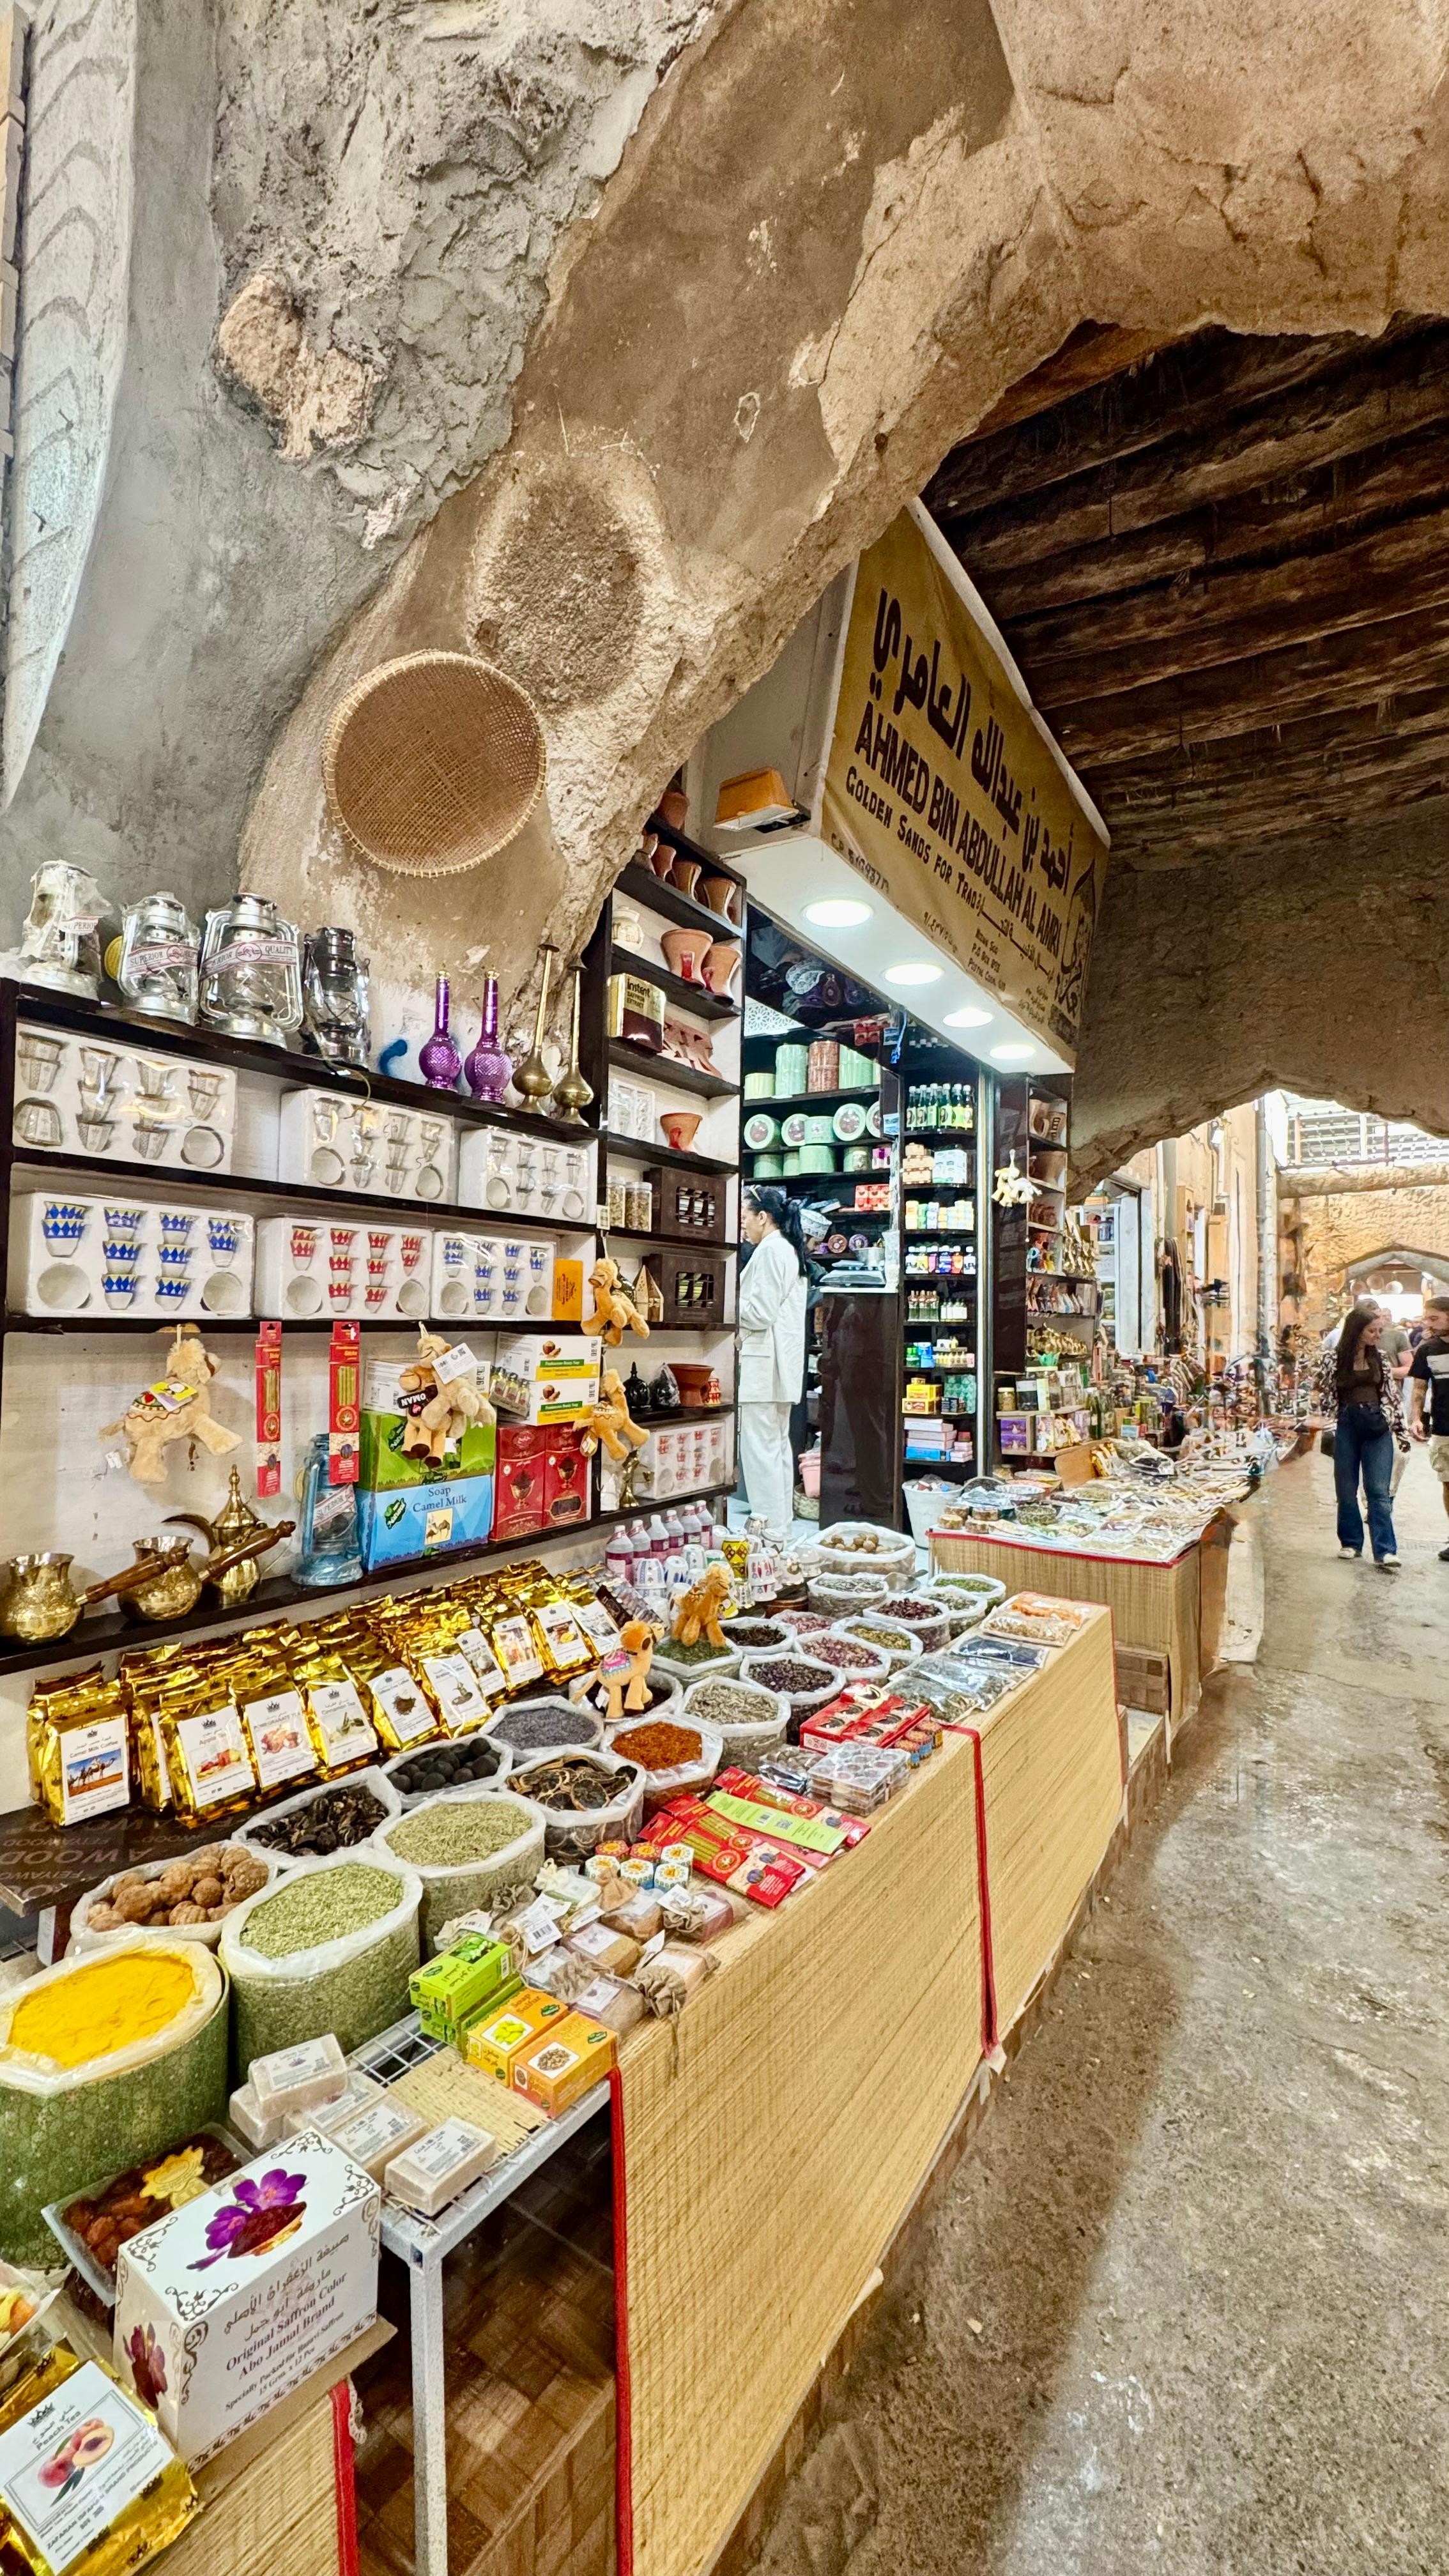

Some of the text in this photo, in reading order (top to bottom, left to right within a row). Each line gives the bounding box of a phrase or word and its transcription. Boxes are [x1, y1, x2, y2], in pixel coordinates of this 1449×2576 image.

[871, 586, 971, 762] العامري
[855, 701, 1062, 958] AHMED BIN ABDULLAH AL AMRI
[933, 854, 952, 884] FOR
[130, 951, 164, 965] SUPERIOR
[265, 945, 294, 955] QUALITY
[627, 978, 650, 998] instant
[401, 1393, 426, 1407] OMAN
[412, 1494, 467, 1512] Camel Milk
[428, 1485, 452, 1498] Soap
[387, 1503, 406, 1529] Natural
[512, 1993, 531, 2007] Soap
[517, 1996, 542, 2014] Sulfur
[226, 2273, 347, 2372] Original Saffron Color
[240, 2296, 335, 2380] Abo Jamal Brand
[226, 2383, 257, 2411] Specially
[259, 2360, 285, 2384] Packed
[321, 2312, 344, 2333] Saffron
[36, 2411, 80, 2450] Peach Tea
[126, 2440, 158, 2472] PRODUCTS
